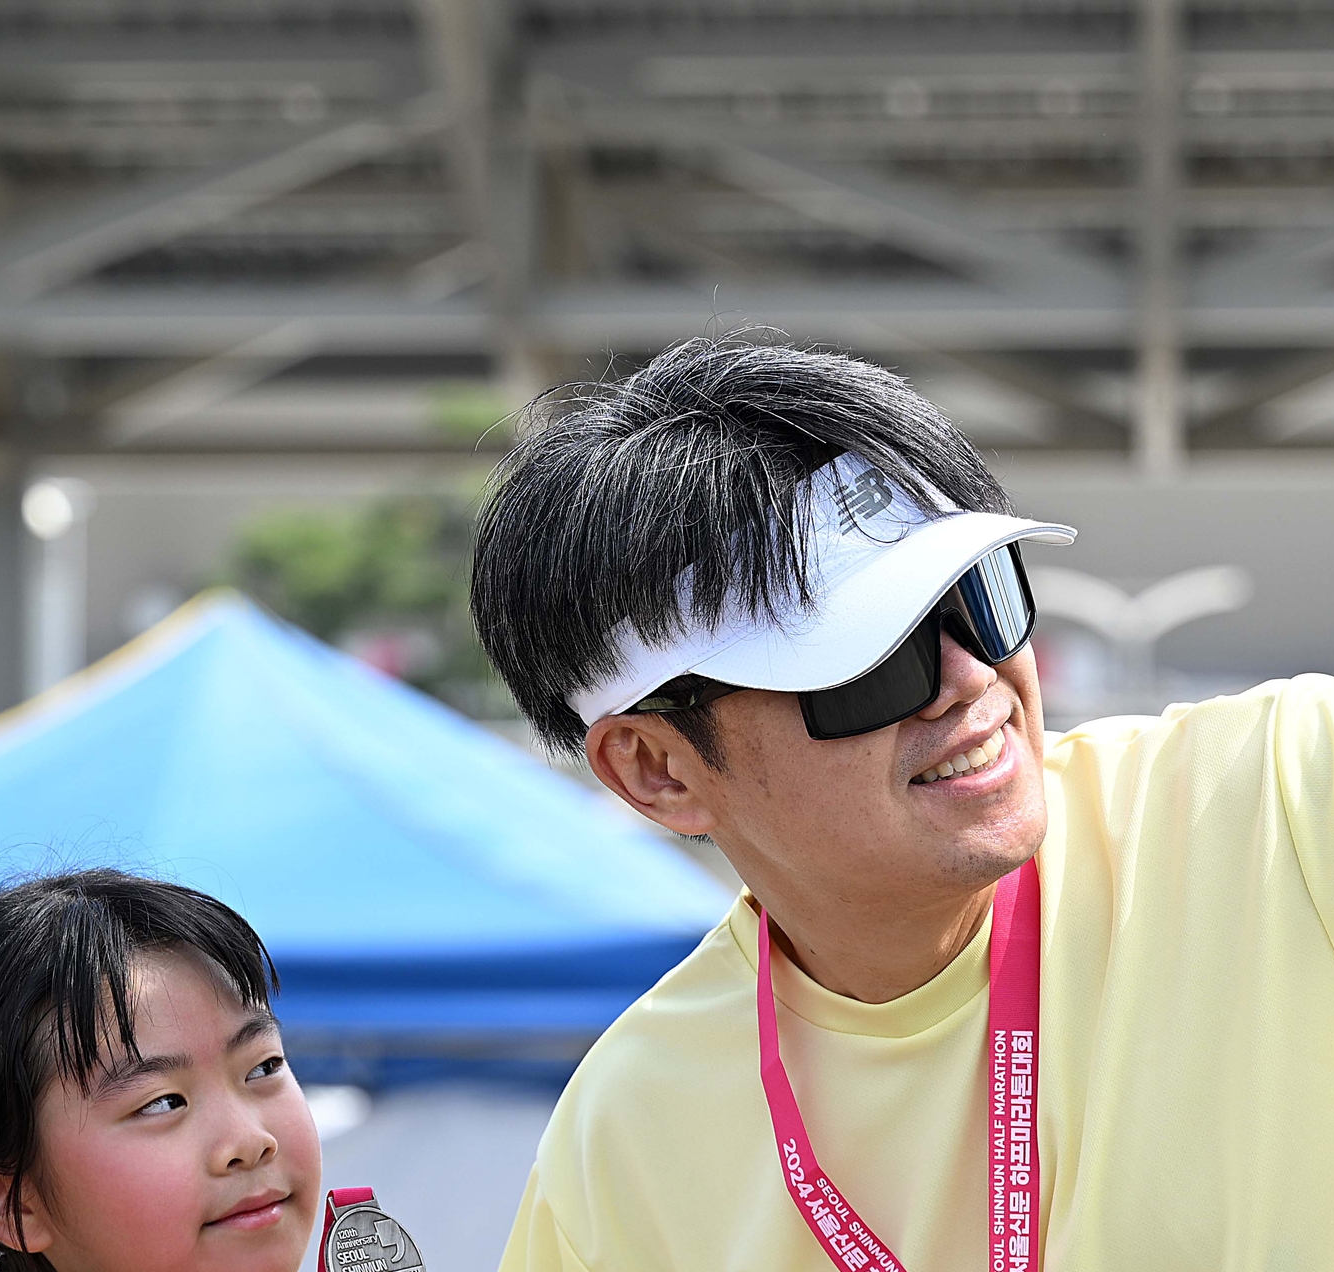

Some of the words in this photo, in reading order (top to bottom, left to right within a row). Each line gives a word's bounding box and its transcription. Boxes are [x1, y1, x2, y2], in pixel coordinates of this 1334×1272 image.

[994, 1030, 1006, 1116] MARATHON
[1010, 1031, 1033, 1186] 하프마라톤대회
[994, 1121, 1005, 1159] HALF
[782, 1138, 815, 1200] 2024
[806, 1198, 869, 1272] 서울신문
[815, 1177, 850, 1224] SEOUL
[993, 1164, 1005, 1239] SHINMUN
[336, 1232, 379, 1251] Anniversary
[336, 1248, 370, 1265] SEOUL
[337, 1227, 358, 1240] 120th
